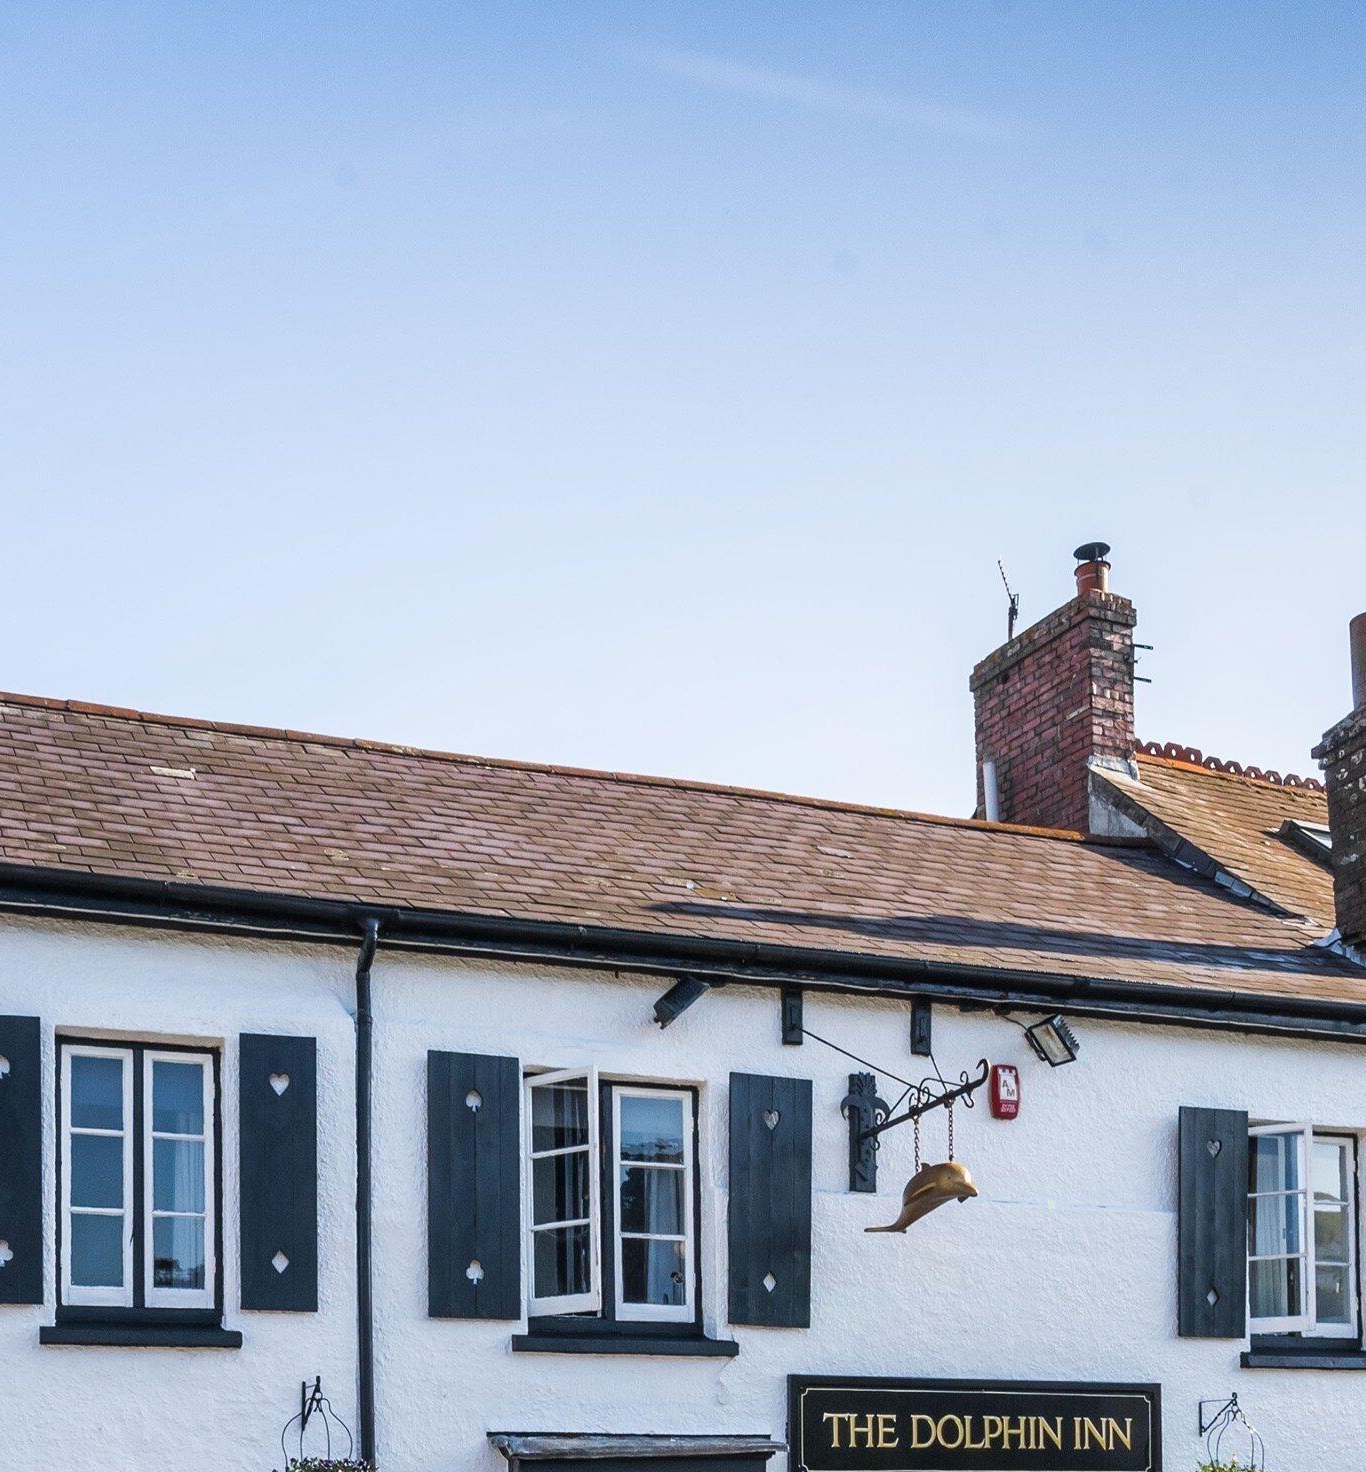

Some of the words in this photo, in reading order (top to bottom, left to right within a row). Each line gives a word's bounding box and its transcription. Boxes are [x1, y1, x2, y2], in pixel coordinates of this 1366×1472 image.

[822, 1412, 900, 1449] THE
[910, 1414, 1064, 1450] DOLPHIN
[1073, 1417, 1133, 1451] INN
